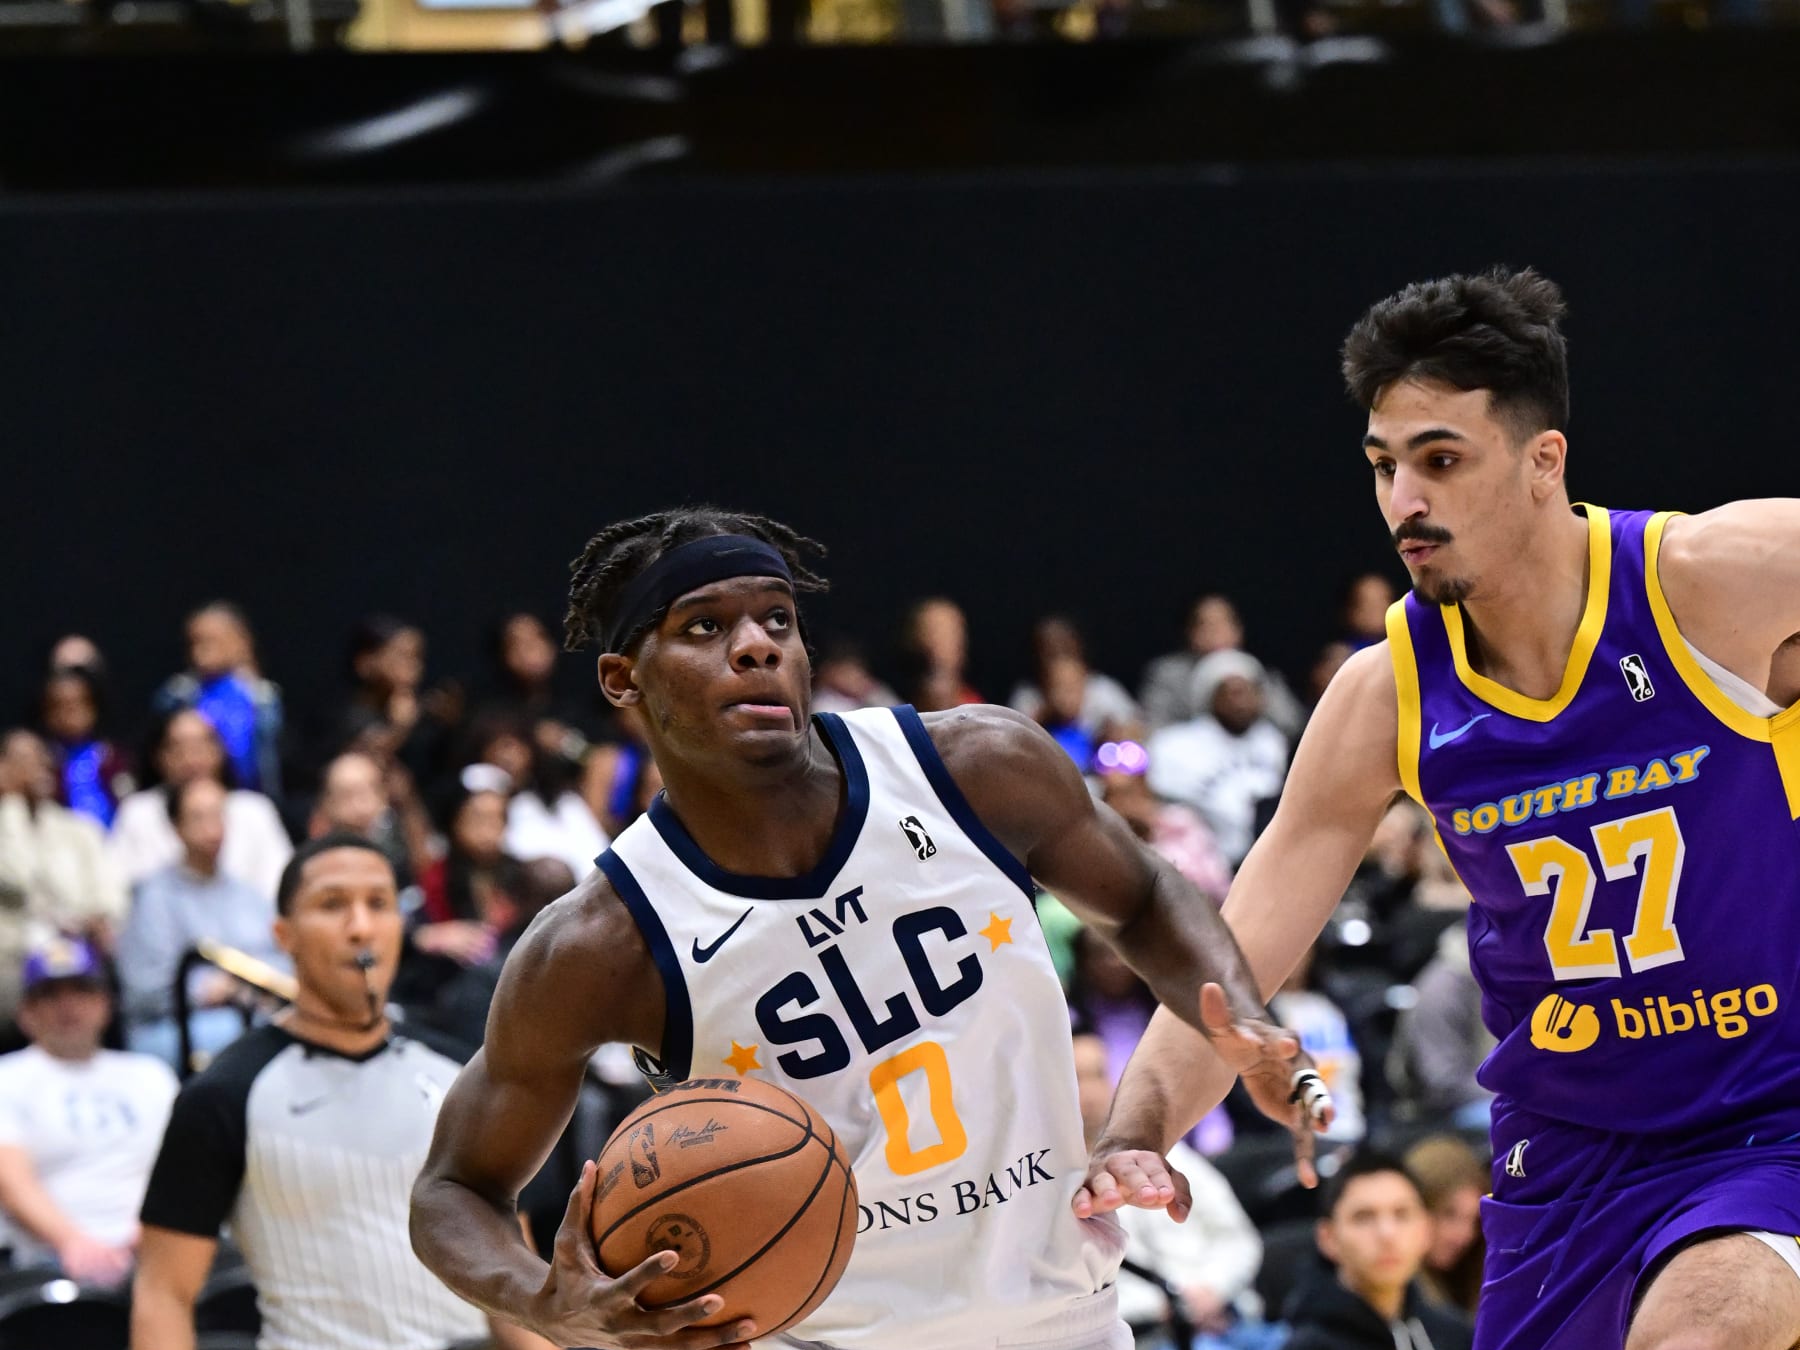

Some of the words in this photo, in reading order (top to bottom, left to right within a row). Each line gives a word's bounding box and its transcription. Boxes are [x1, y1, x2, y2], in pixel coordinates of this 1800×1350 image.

[1452, 773, 1600, 835] SOUTH
[1603, 745, 1710, 800] BAY
[796, 885, 868, 948] LVT
[1505, 805, 1686, 982] 27
[755, 906, 984, 1080] SLC
[1610, 983, 1778, 1039] bibigo
[869, 1041, 968, 1176] 0
[952, 1148, 1055, 1216] BANK
